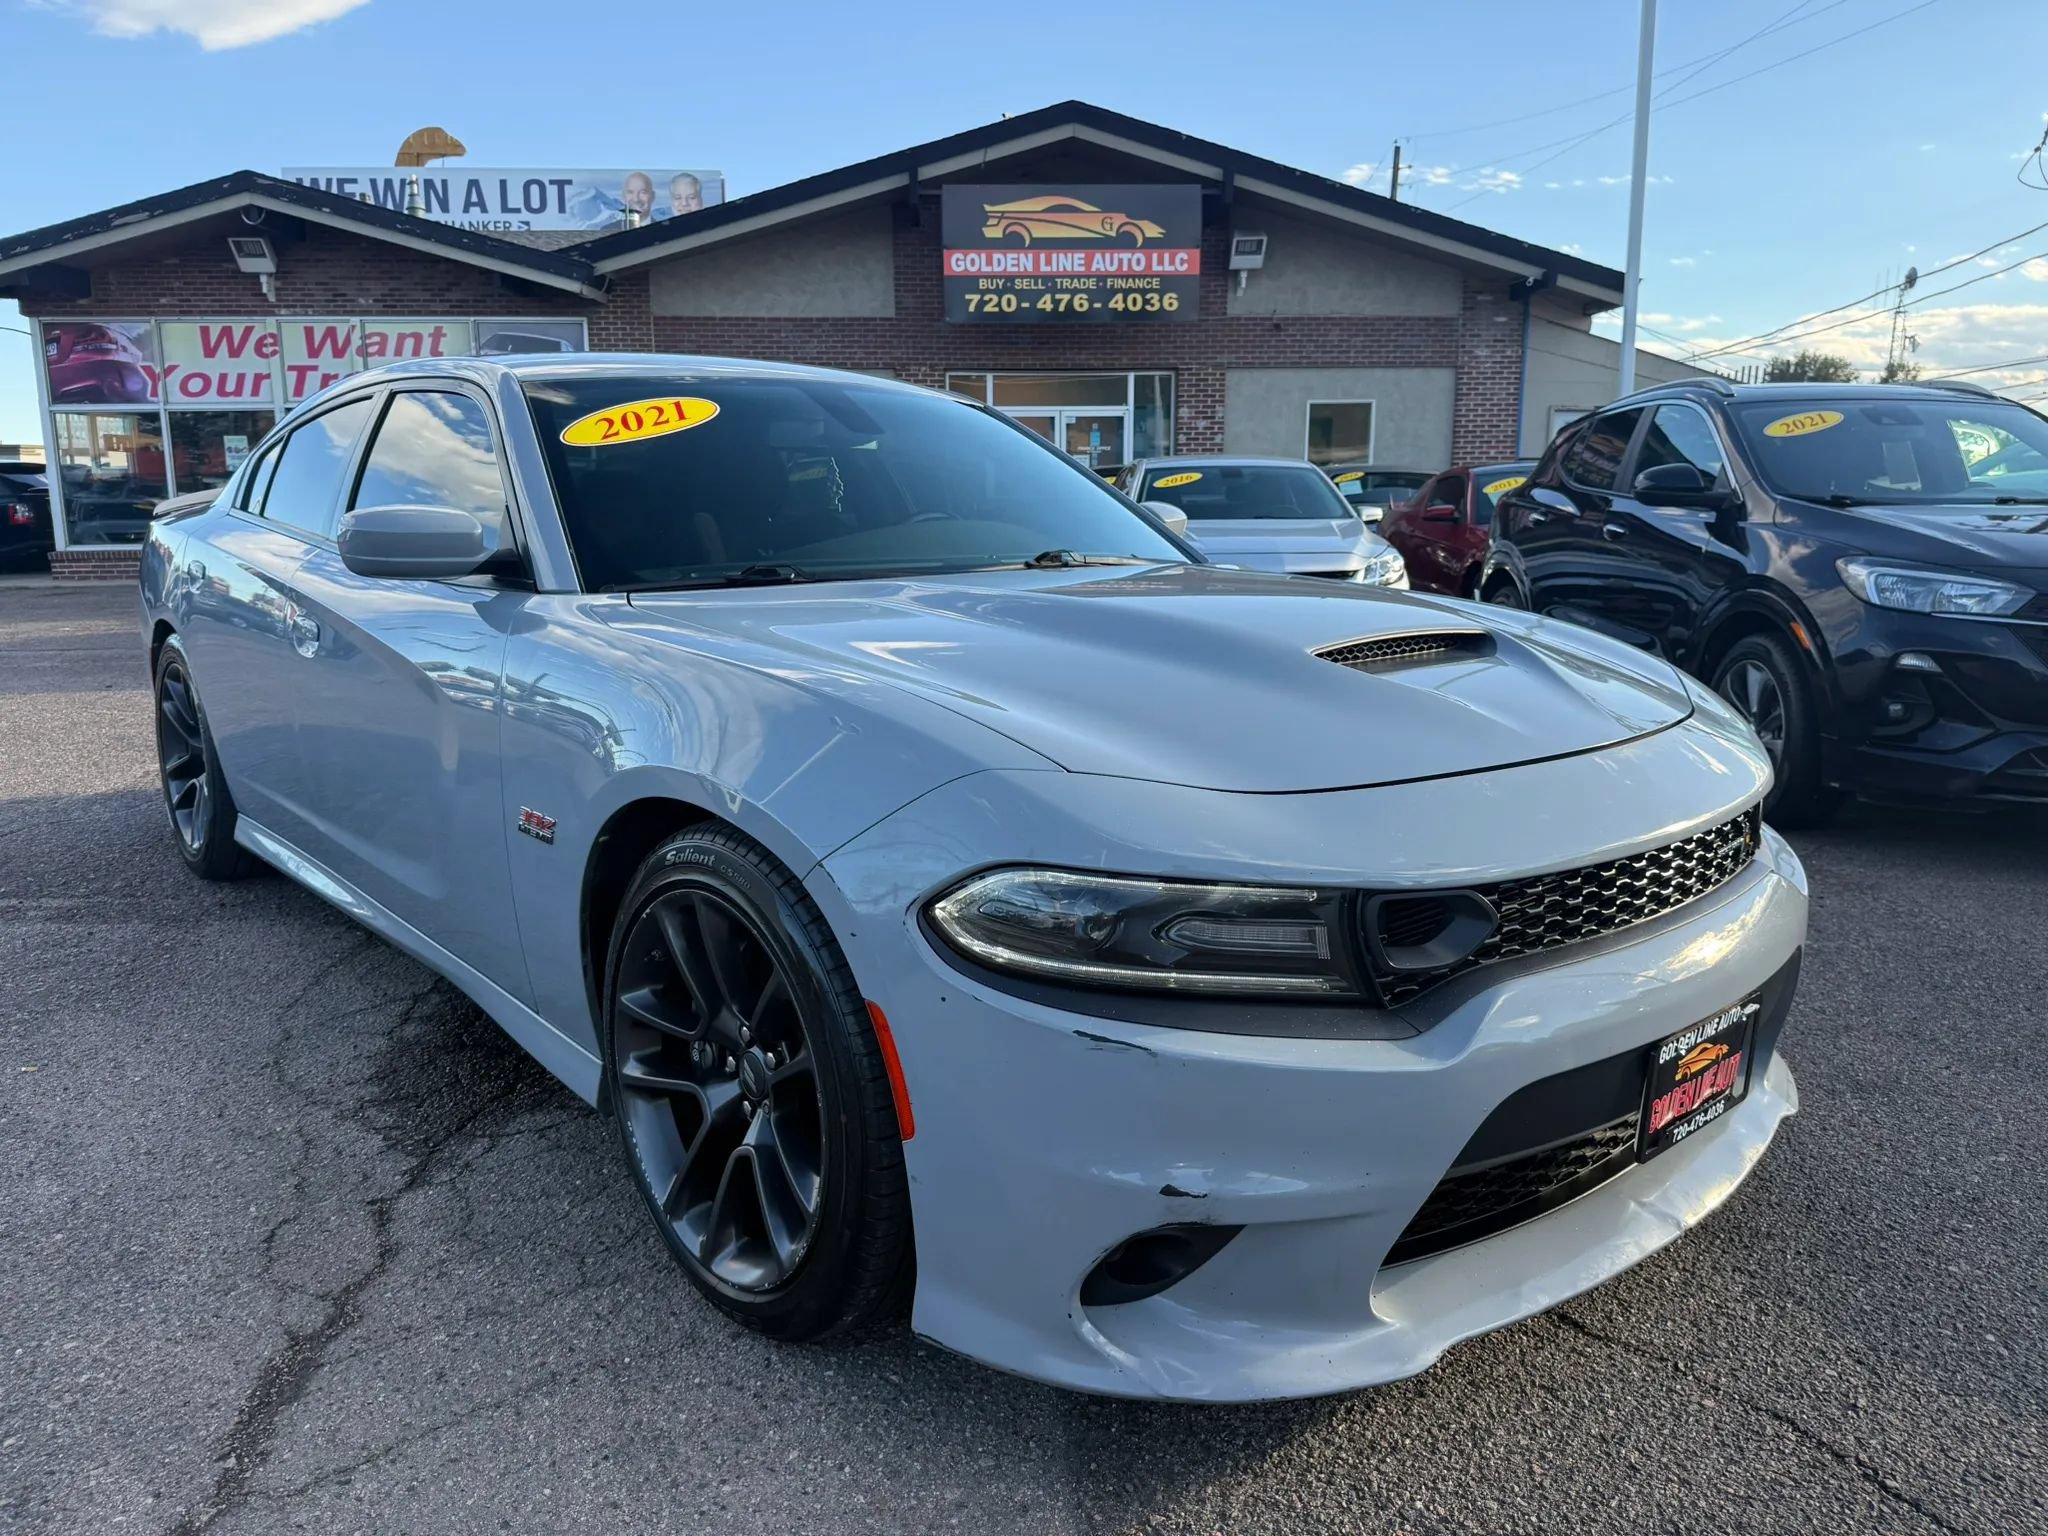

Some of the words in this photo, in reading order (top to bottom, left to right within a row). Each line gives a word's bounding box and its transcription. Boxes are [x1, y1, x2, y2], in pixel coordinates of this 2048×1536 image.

[369, 177, 450, 214] WN
[462, 178, 490, 214] A
[500, 178, 574, 214] LOT
[950, 252, 1033, 273] GOLDEN
[1039, 252, 1086, 272] LINE
[1091, 252, 1146, 272] AUTO
[1151, 252, 1189, 272] LLC
[978, 278, 1006, 290] BUY
[1014, 278, 1046, 290] SELL
[1055, 278, 1098, 290] TRADE
[1106, 278, 1161, 289] FINANCE
[199, 324, 280, 360] We
[303, 325, 447, 359] Want
[142, 364, 272, 398] Your
[287, 364, 361, 397] Tr
[594, 400, 692, 441] 2021
[1779, 412, 1828, 435] 2021
[665, 848, 716, 867] Salient
[1696, 1017, 1720, 1044] LINE
[1717, 1005, 1741, 1032] AUTO
[1672, 1099, 1725, 1143] 720-476-4036
